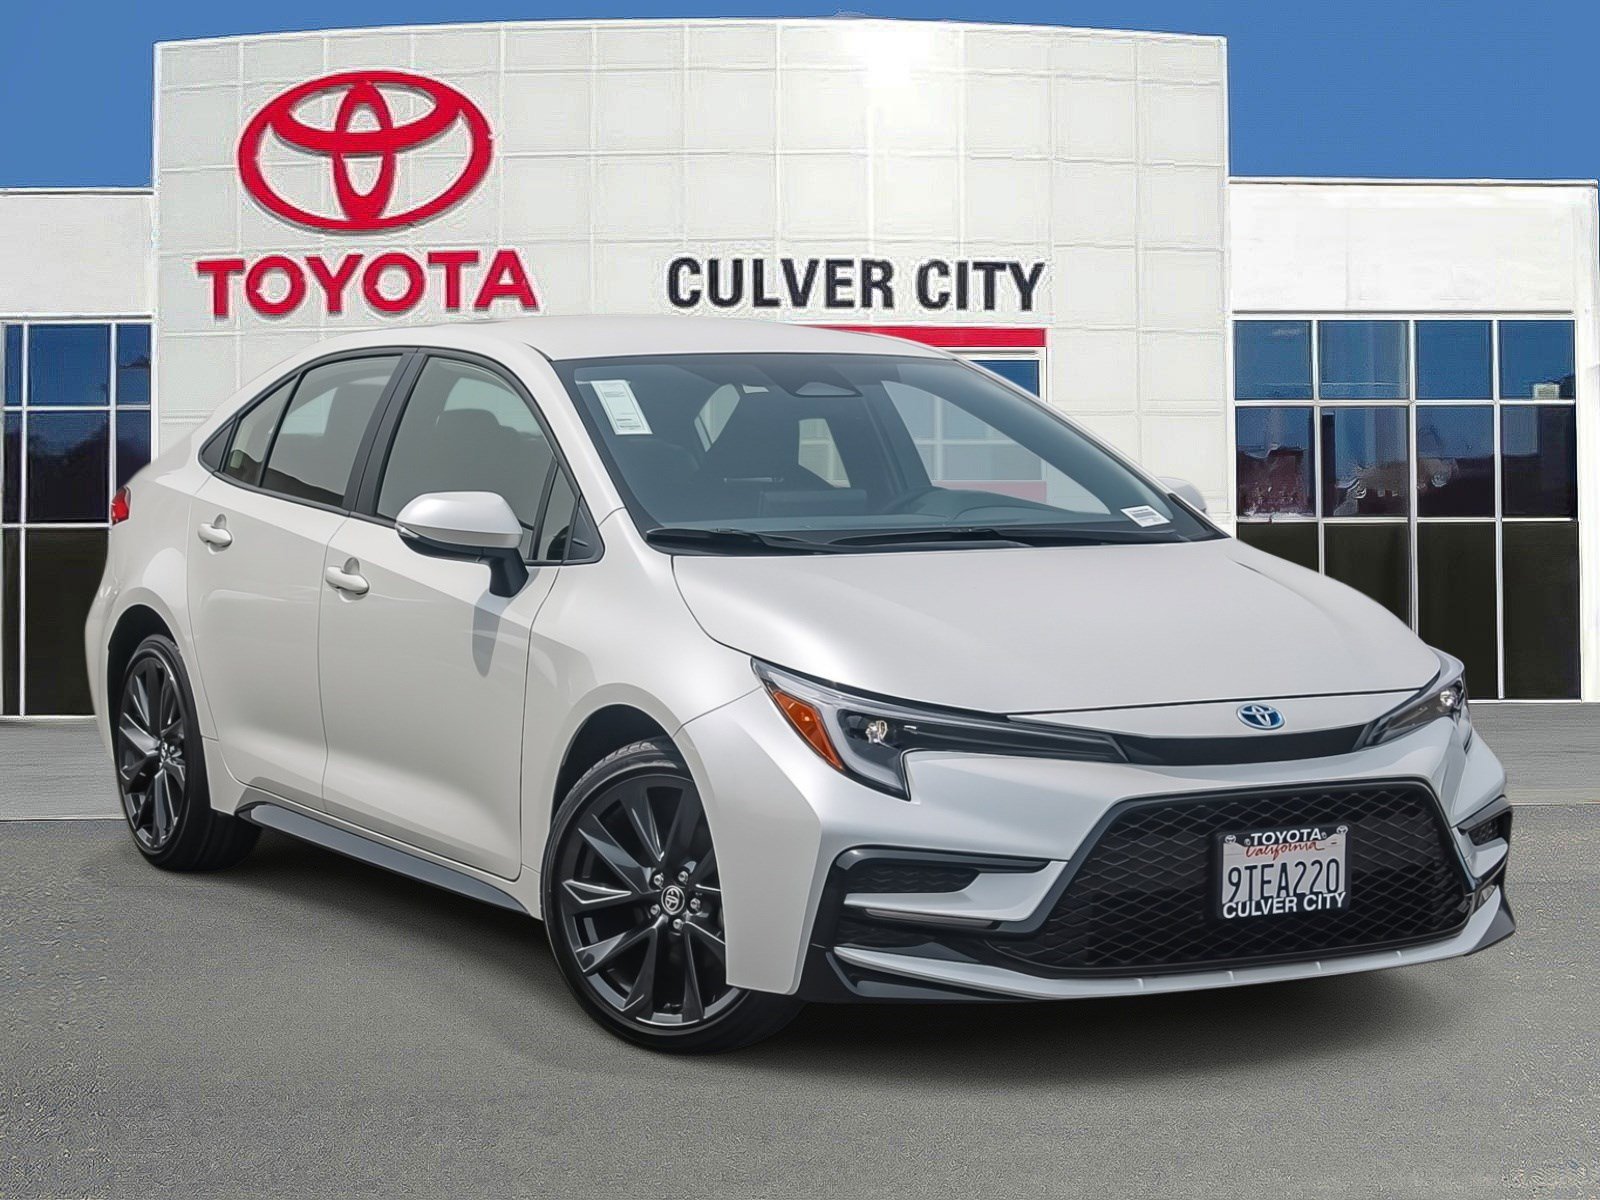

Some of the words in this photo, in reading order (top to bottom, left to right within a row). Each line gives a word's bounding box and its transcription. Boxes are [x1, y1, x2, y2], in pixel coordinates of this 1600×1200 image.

[196, 249, 539, 318] TOYOTA
[667, 256, 895, 308] CULVER
[916, 259, 1046, 311] CITY
[1245, 841, 1325, 860] California
[1251, 828, 1322, 846] TOYOTA
[1228, 858, 1340, 904] 9TEA220
[1223, 896, 1298, 918] CULVER
[1303, 892, 1346, 911] CITY
